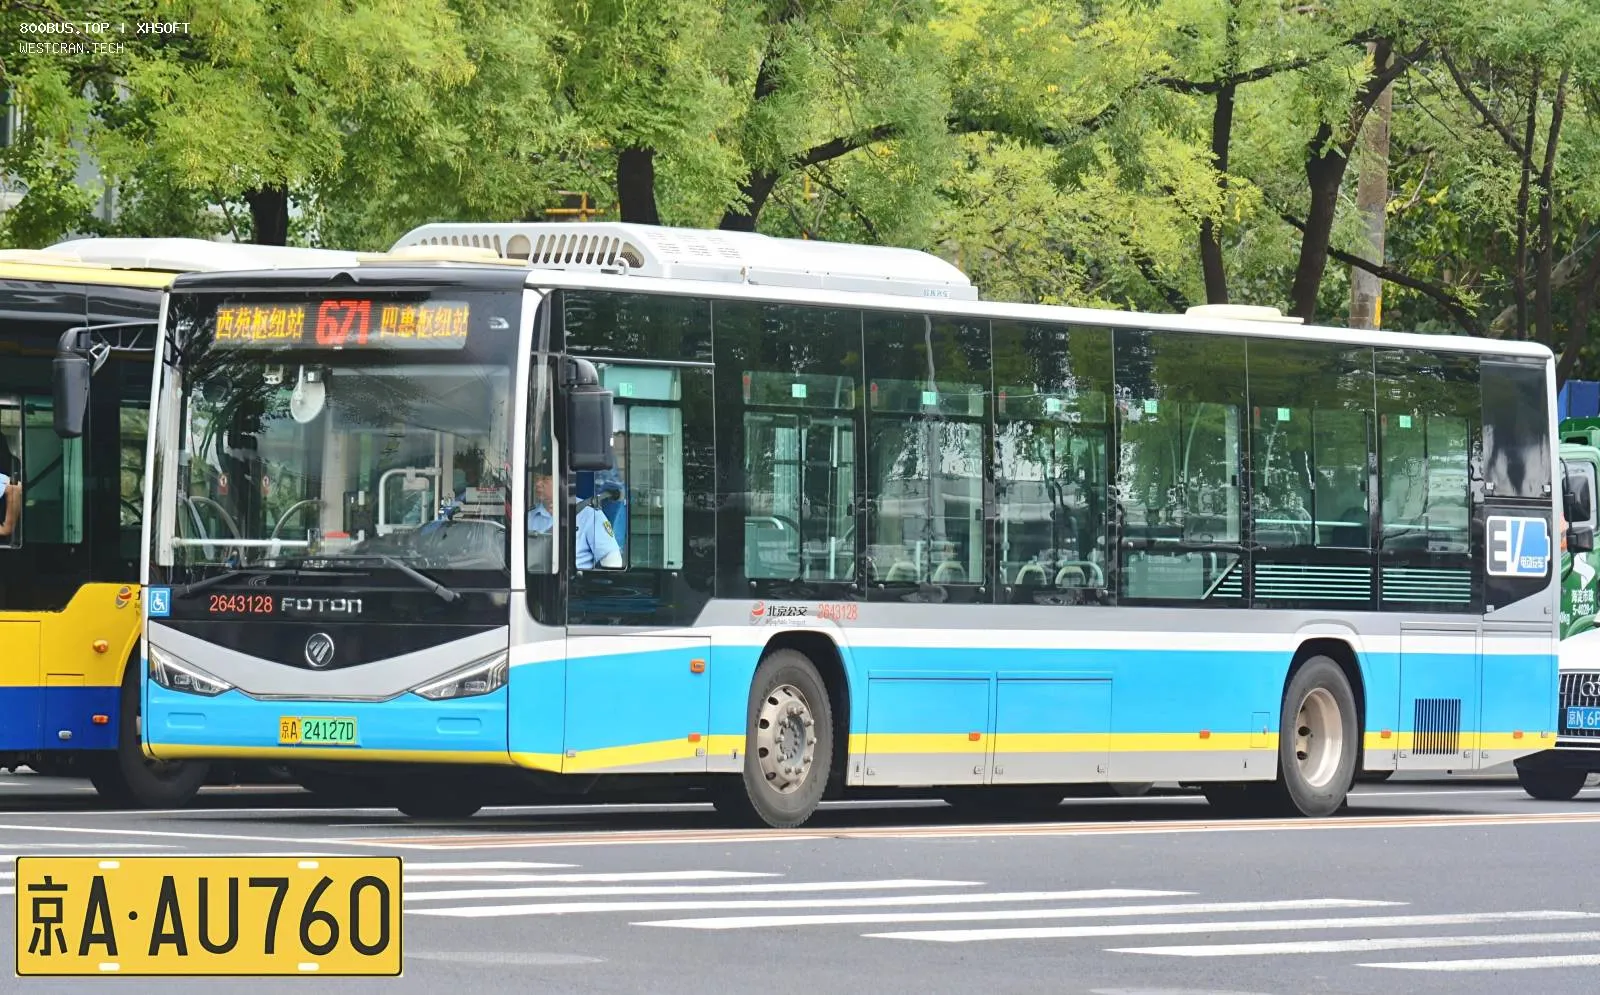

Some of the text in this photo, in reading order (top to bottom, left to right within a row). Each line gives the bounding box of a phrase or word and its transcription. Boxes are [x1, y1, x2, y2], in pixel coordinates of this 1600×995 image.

[215, 300, 469, 345] 西苑枢纽站 671 四惠枢纽站
[209, 595, 273, 613] 2643128
[281, 598, 362, 613] FOTON
[767, 605, 808, 616] 北京公交
[816, 603, 858, 620] 2643128
